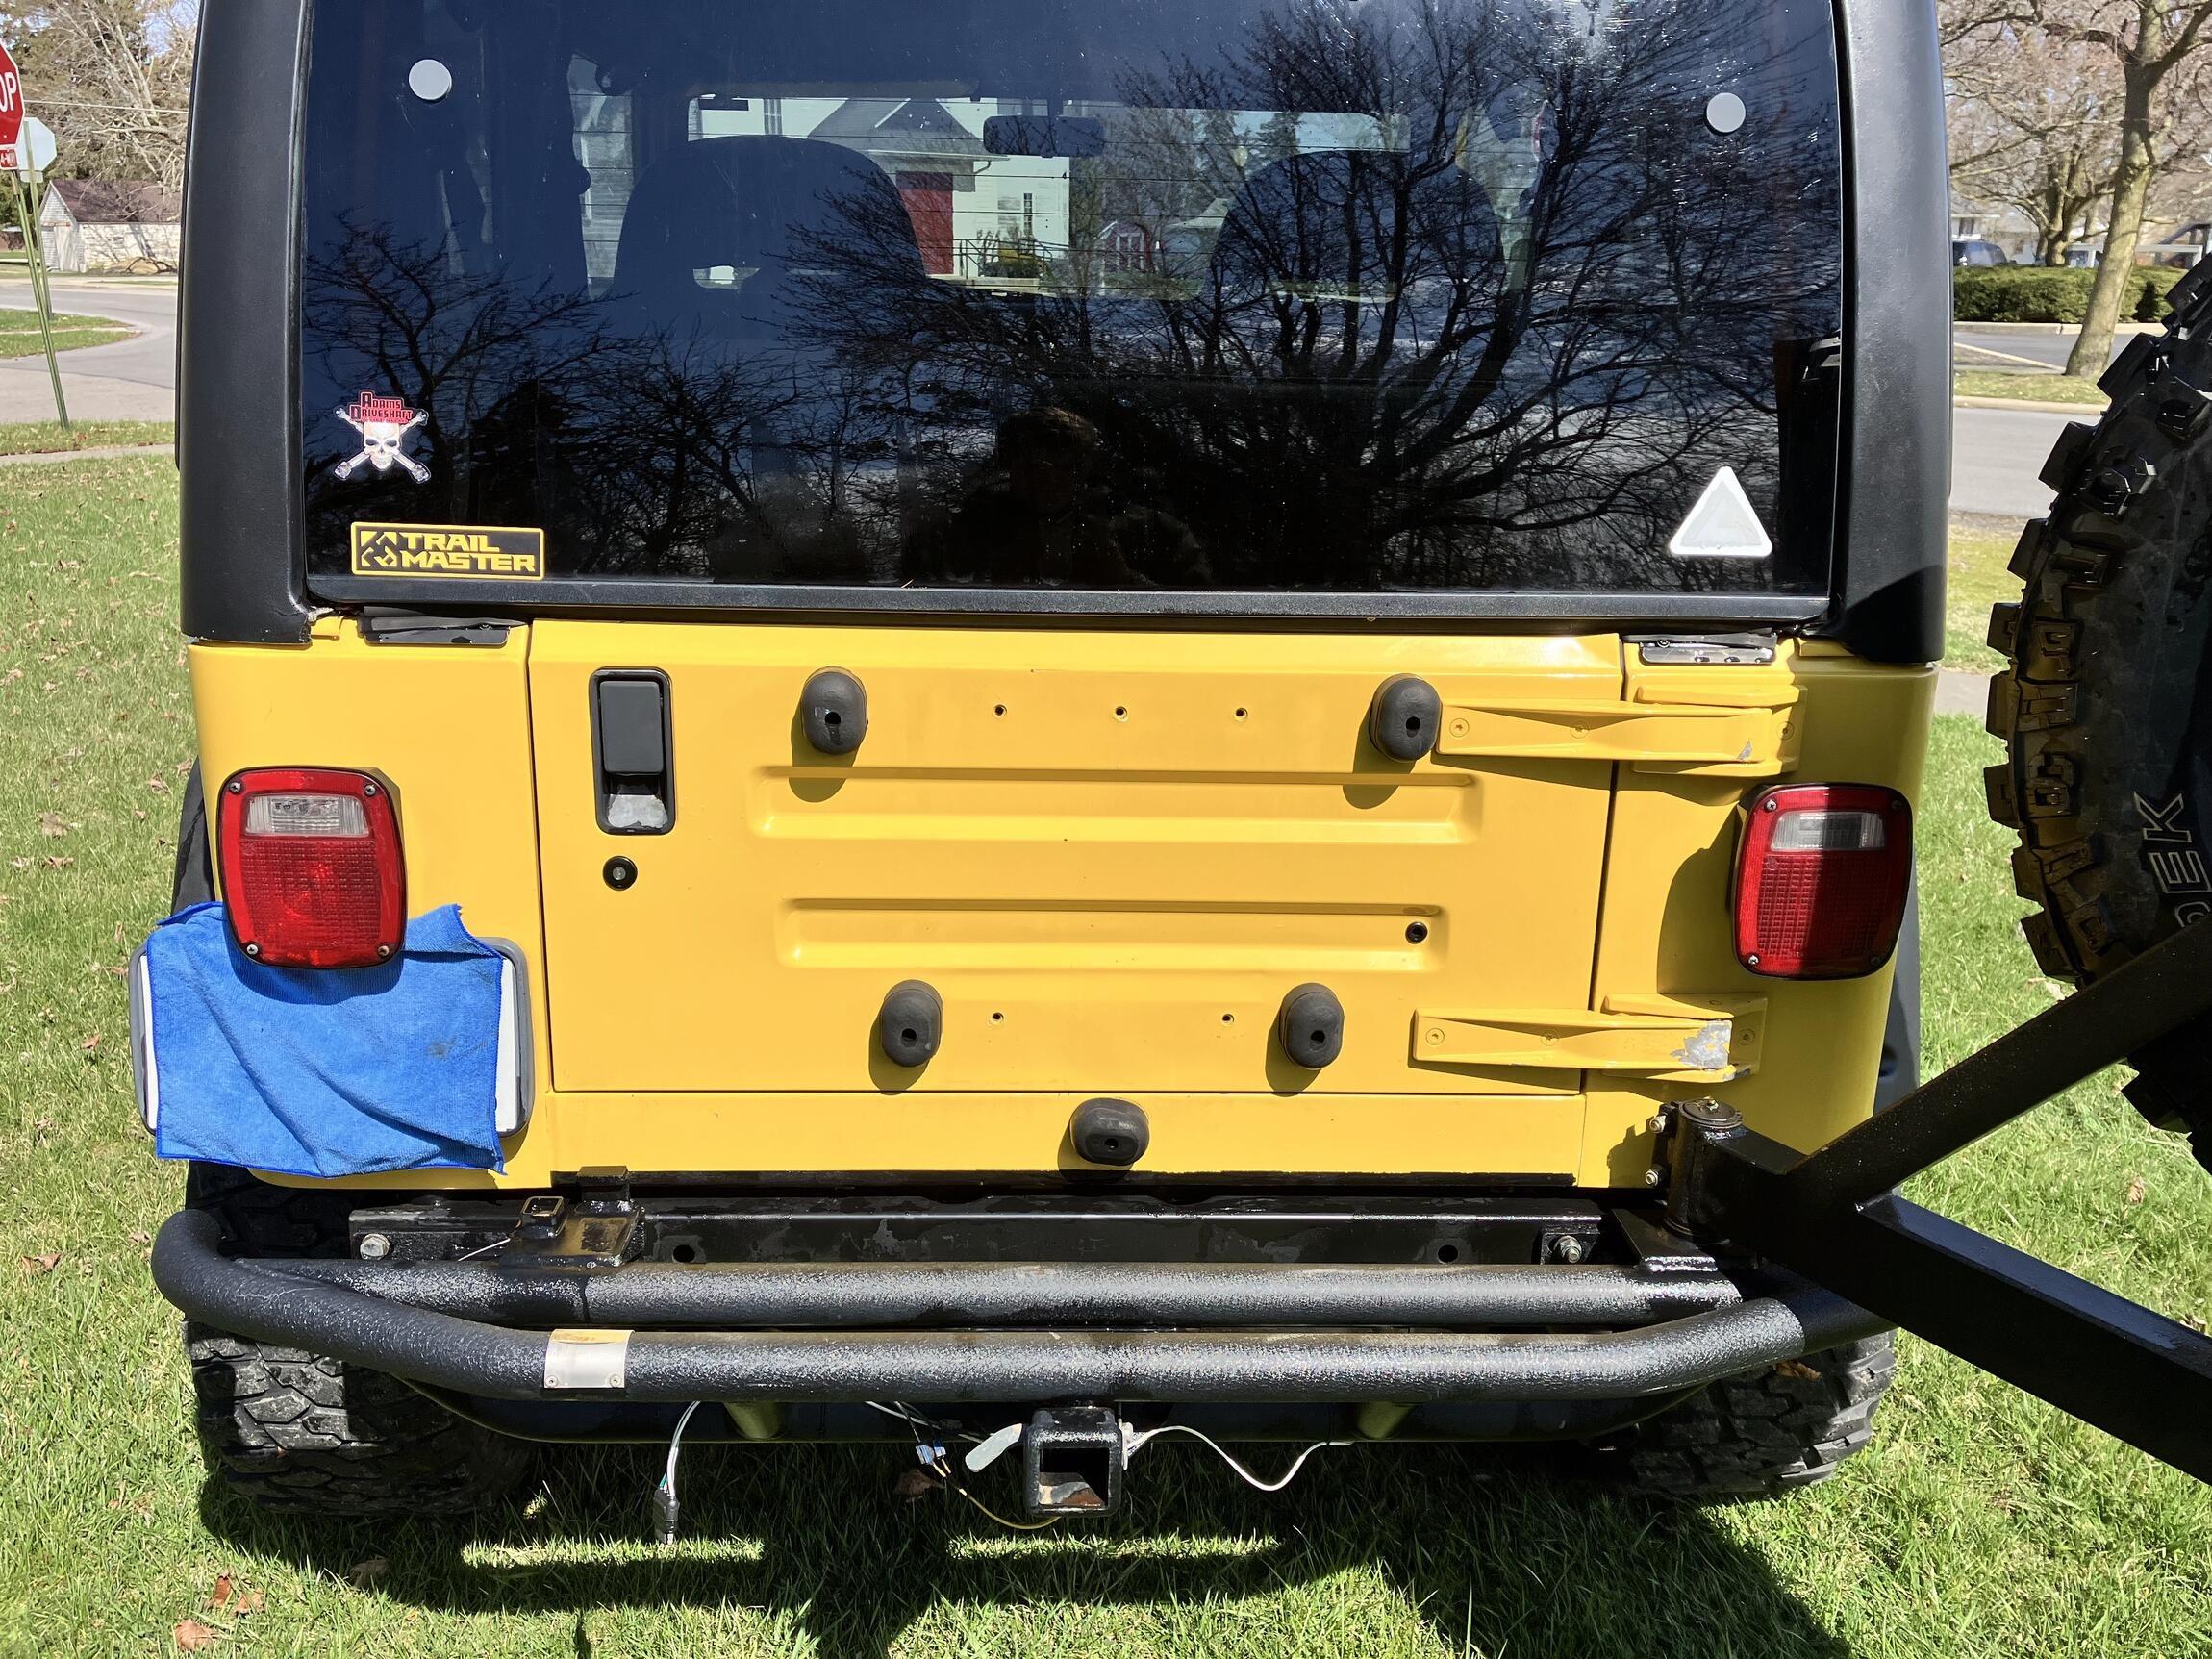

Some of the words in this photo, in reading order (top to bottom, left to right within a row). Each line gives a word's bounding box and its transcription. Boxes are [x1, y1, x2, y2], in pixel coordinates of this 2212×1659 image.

[361, 392, 402, 409] ADAMS
[350, 405, 414, 420] DRIVESHAFT
[399, 532, 500, 553] TRAIL
[399, 550, 536, 572] MASTER
